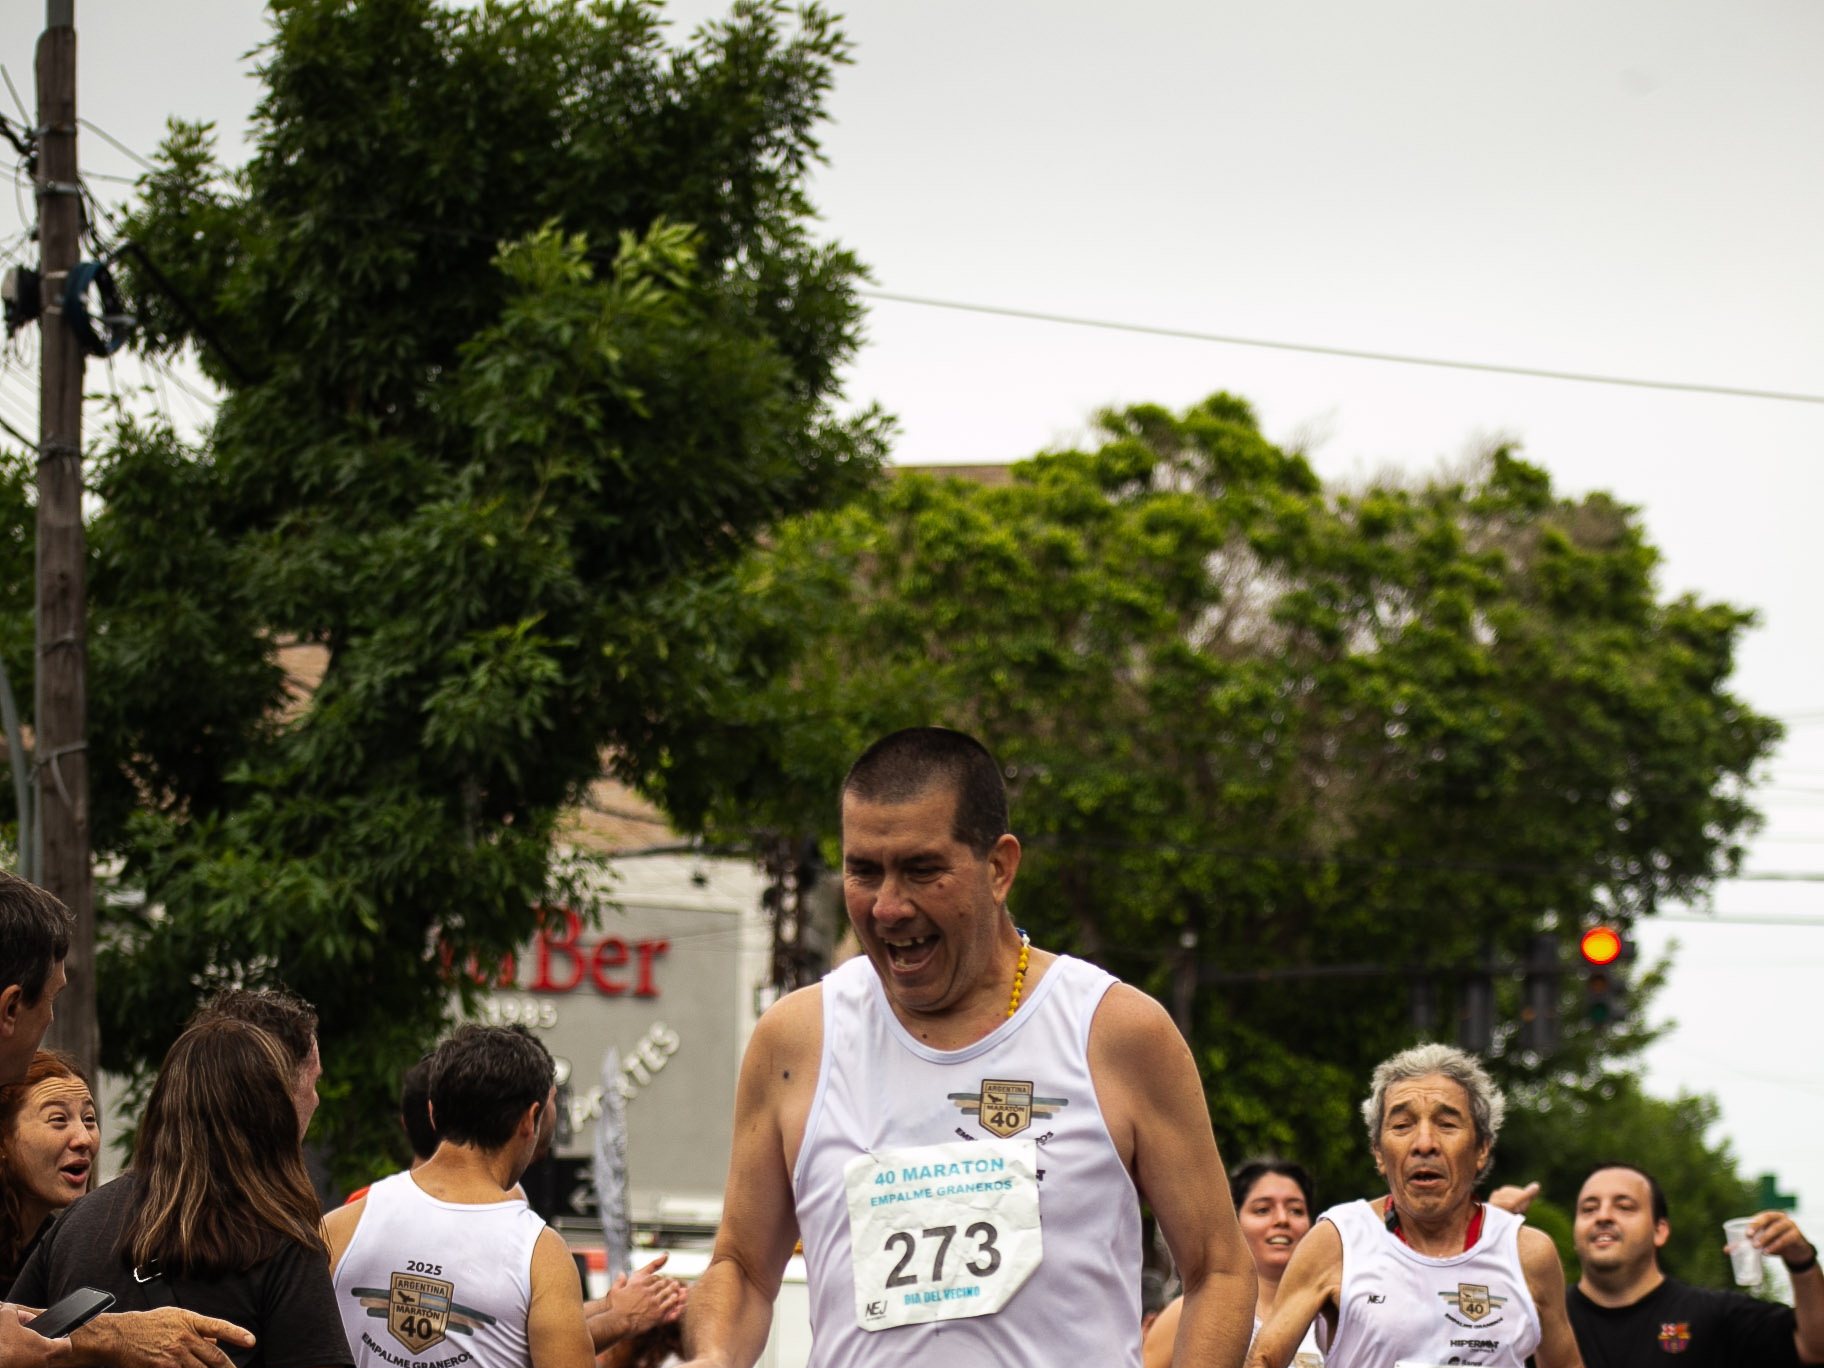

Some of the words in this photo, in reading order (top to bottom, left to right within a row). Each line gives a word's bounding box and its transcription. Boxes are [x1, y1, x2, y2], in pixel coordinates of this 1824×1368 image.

[987, 1085, 1027, 1094] ARGENTINA
[990, 1112, 1020, 1128] 40
[874, 1170, 896, 1187] 40
[902, 1157, 1005, 1183] MARATON
[870, 1187, 934, 1208] EMPALME
[936, 1179, 1013, 1197] GRANEROS
[883, 1221, 1002, 1290] 273
[406, 1260, 443, 1276] 2025
[397, 1279, 446, 1296] ARGENTINA
[904, 1292, 922, 1306] DIA
[923, 1289, 943, 1303] DEL
[943, 1286, 981, 1301] VECINO
[396, 1305, 441, 1321] MARATÓN
[1466, 1303, 1484, 1315] 40
[400, 1315, 433, 1340] 40
[361, 1332, 411, 1368] EMPALME
